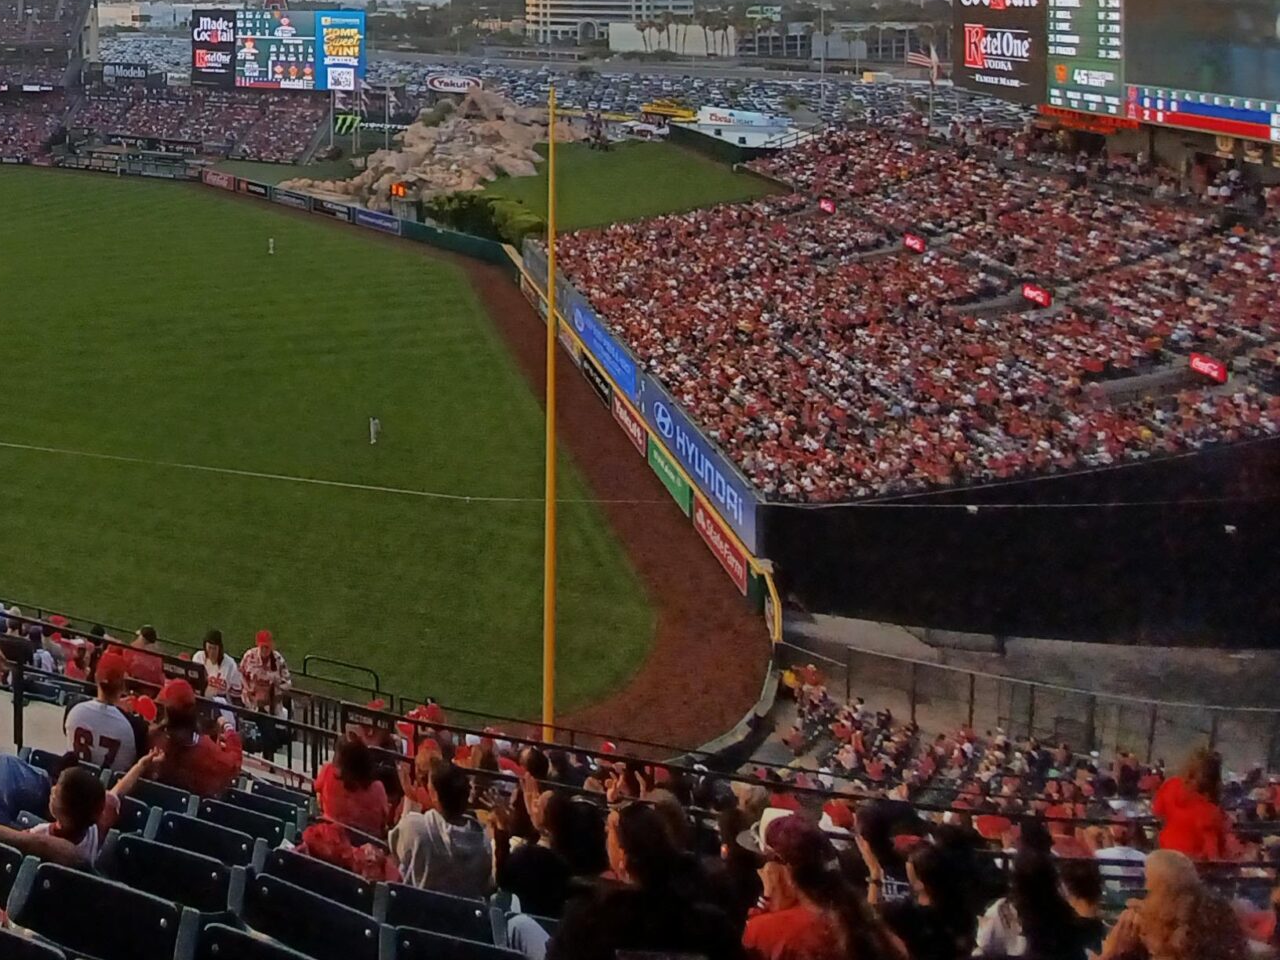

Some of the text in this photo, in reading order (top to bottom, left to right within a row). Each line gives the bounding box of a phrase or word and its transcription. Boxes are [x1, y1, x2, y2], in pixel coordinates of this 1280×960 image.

[199, 16, 228, 29] Made
[323, 28, 358, 37] HOME
[323, 34, 360, 46] Sweet
[964, 24, 1001, 67] Ketel
[1002, 32, 1030, 58] One
[325, 46, 359, 56] WIN!
[983, 59, 1013, 71] VODKA
[115, 65, 145, 78] Modelo
[437, 80, 470, 88] Yakult
[1229, 98, 1235, 107] 7
[676, 426, 743, 526] HYUNDAI
